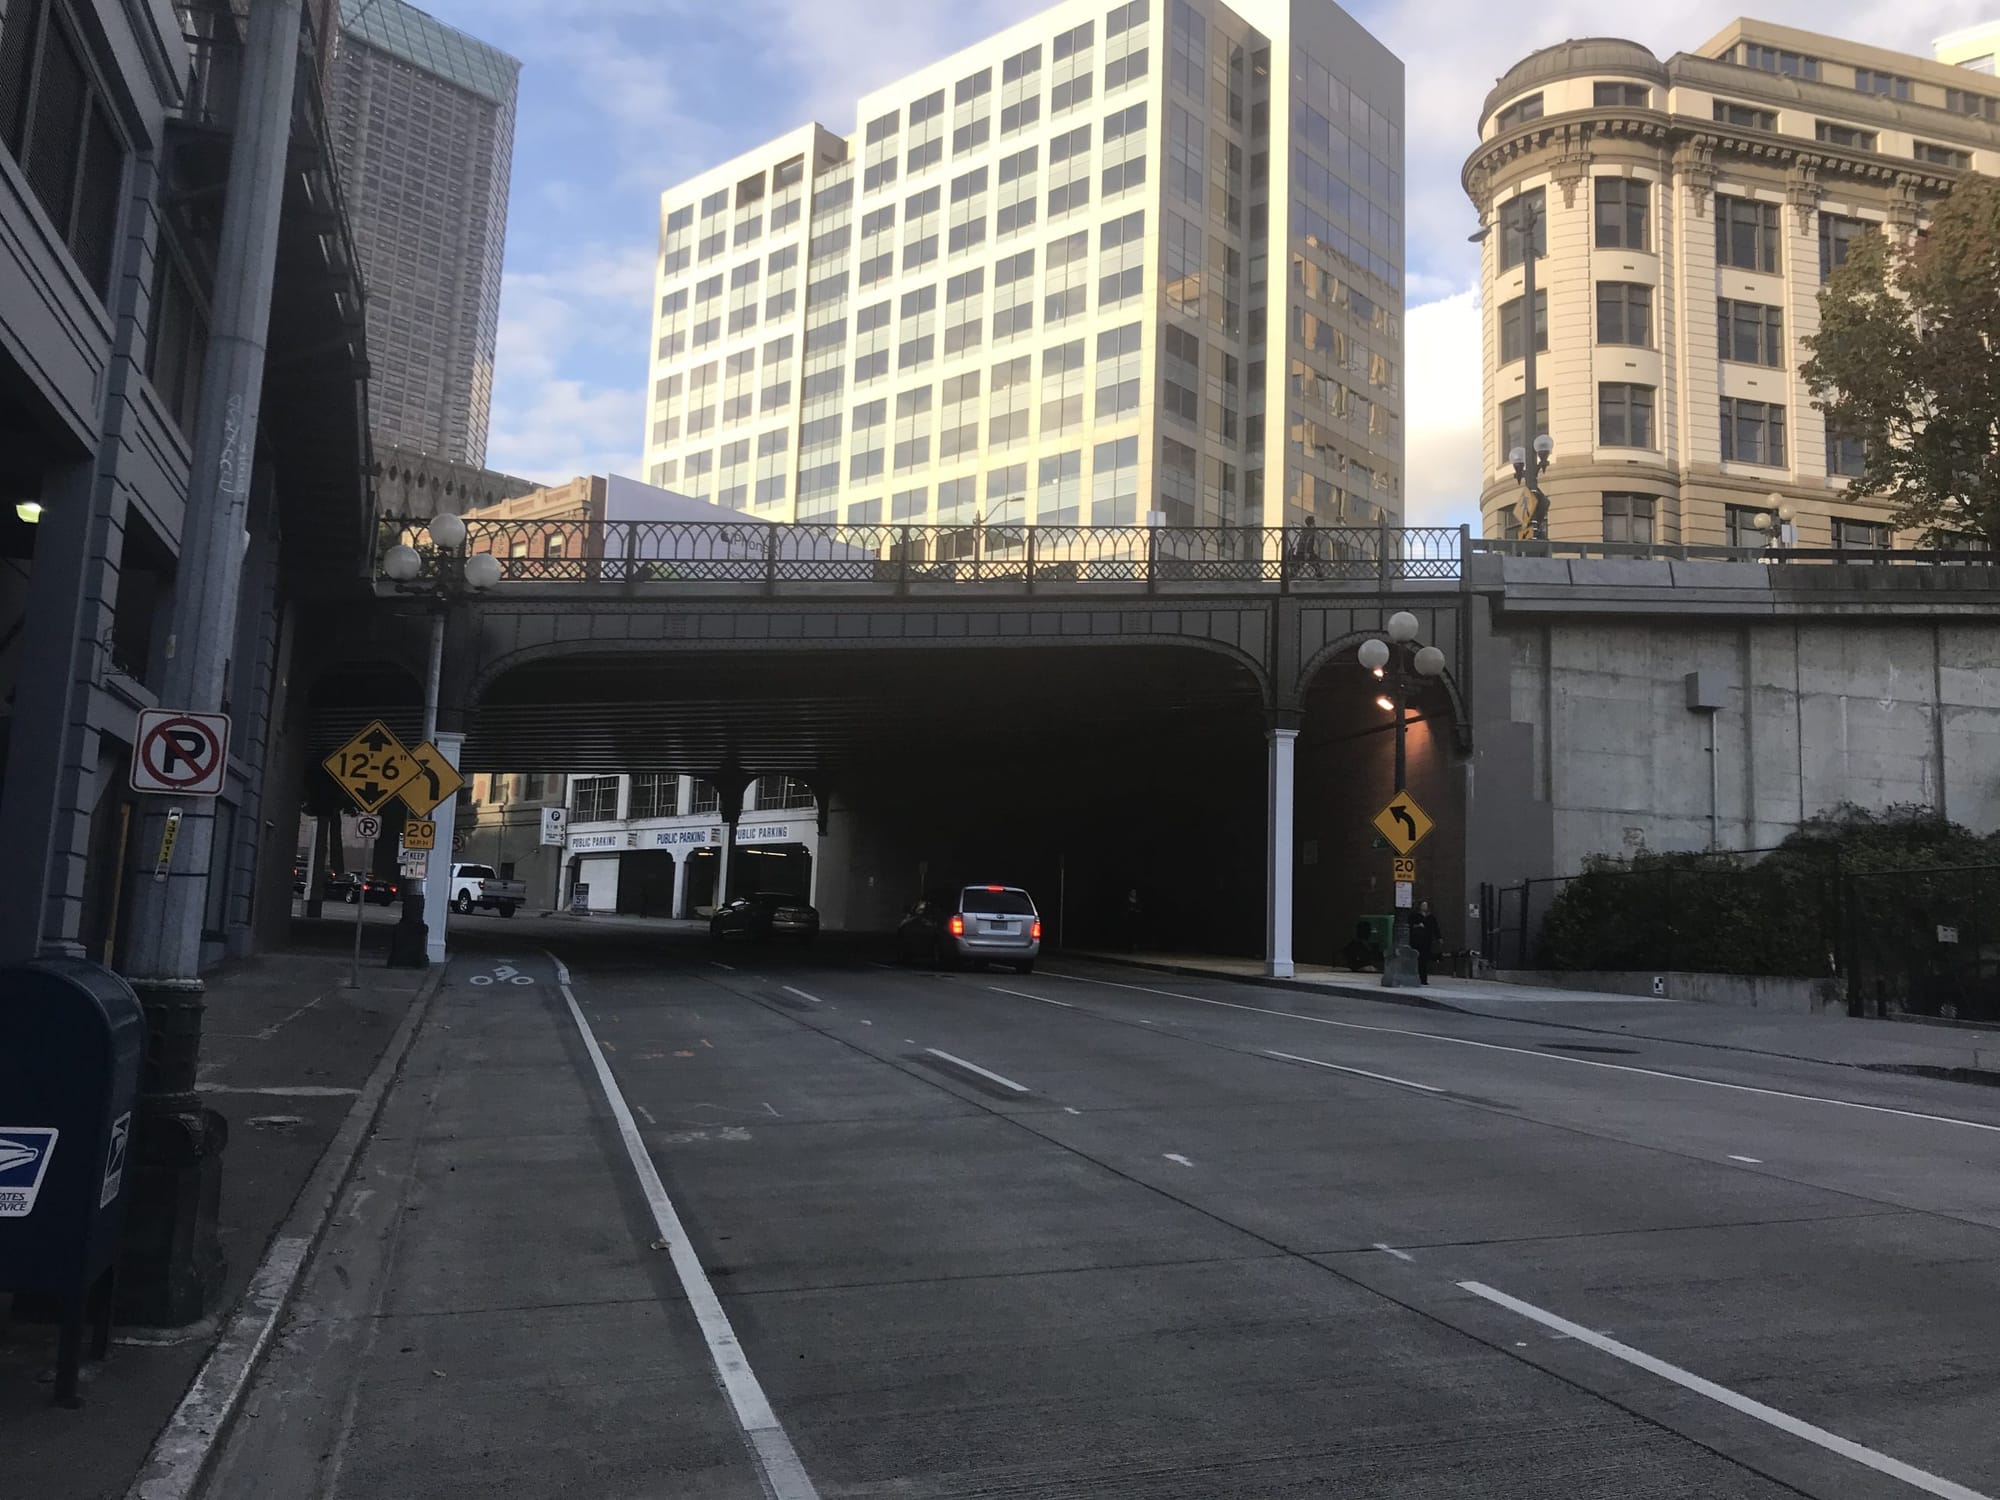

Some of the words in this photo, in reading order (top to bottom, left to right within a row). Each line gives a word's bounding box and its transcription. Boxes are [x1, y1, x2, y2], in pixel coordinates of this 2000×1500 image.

[407, 823, 433, 838] 20
[736, 828, 756, 840] UBLIC
[758, 826, 788, 838] PARKING
[572, 838, 591, 848] PUBLIC
[592, 836, 616, 846] PARKING
[656, 833, 678, 845] PUBLIC
[679, 831, 706, 843] PARKING
[409, 852, 425, 860] KEEP
[1395, 859, 1414, 872] 20
